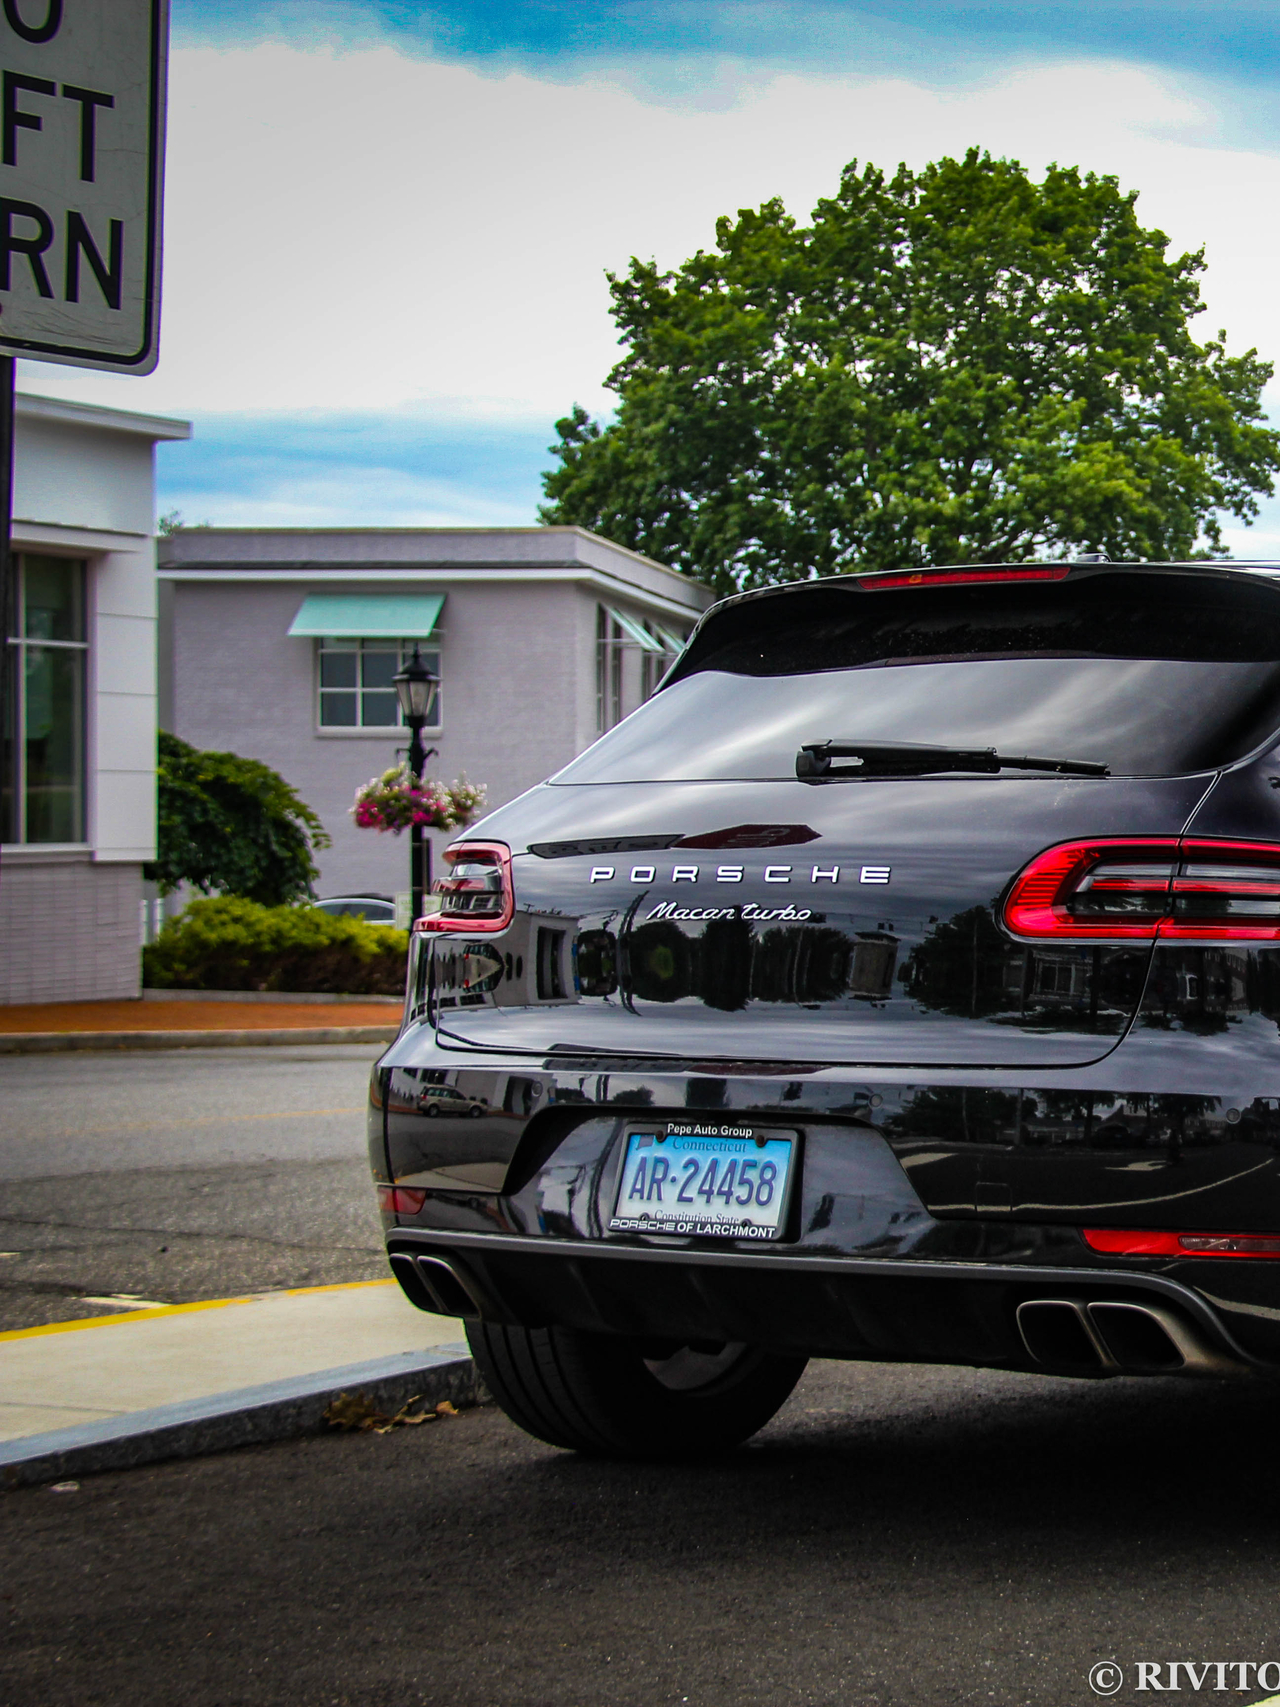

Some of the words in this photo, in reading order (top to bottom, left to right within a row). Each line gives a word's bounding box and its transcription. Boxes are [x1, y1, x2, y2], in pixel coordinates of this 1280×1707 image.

[590, 866, 891, 884] PORSCHE
[646, 901, 735, 920] Macan
[667, 1123, 691, 1136] Pepe
[694, 1124, 718, 1135] Auto
[720, 1126, 752, 1138] Group
[673, 1136, 747, 1153] Connecticut
[610, 1218, 675, 1231] PORSCHE
[677, 1222, 694, 1233] OF
[697, 1224, 775, 1238] LARCHMONT
